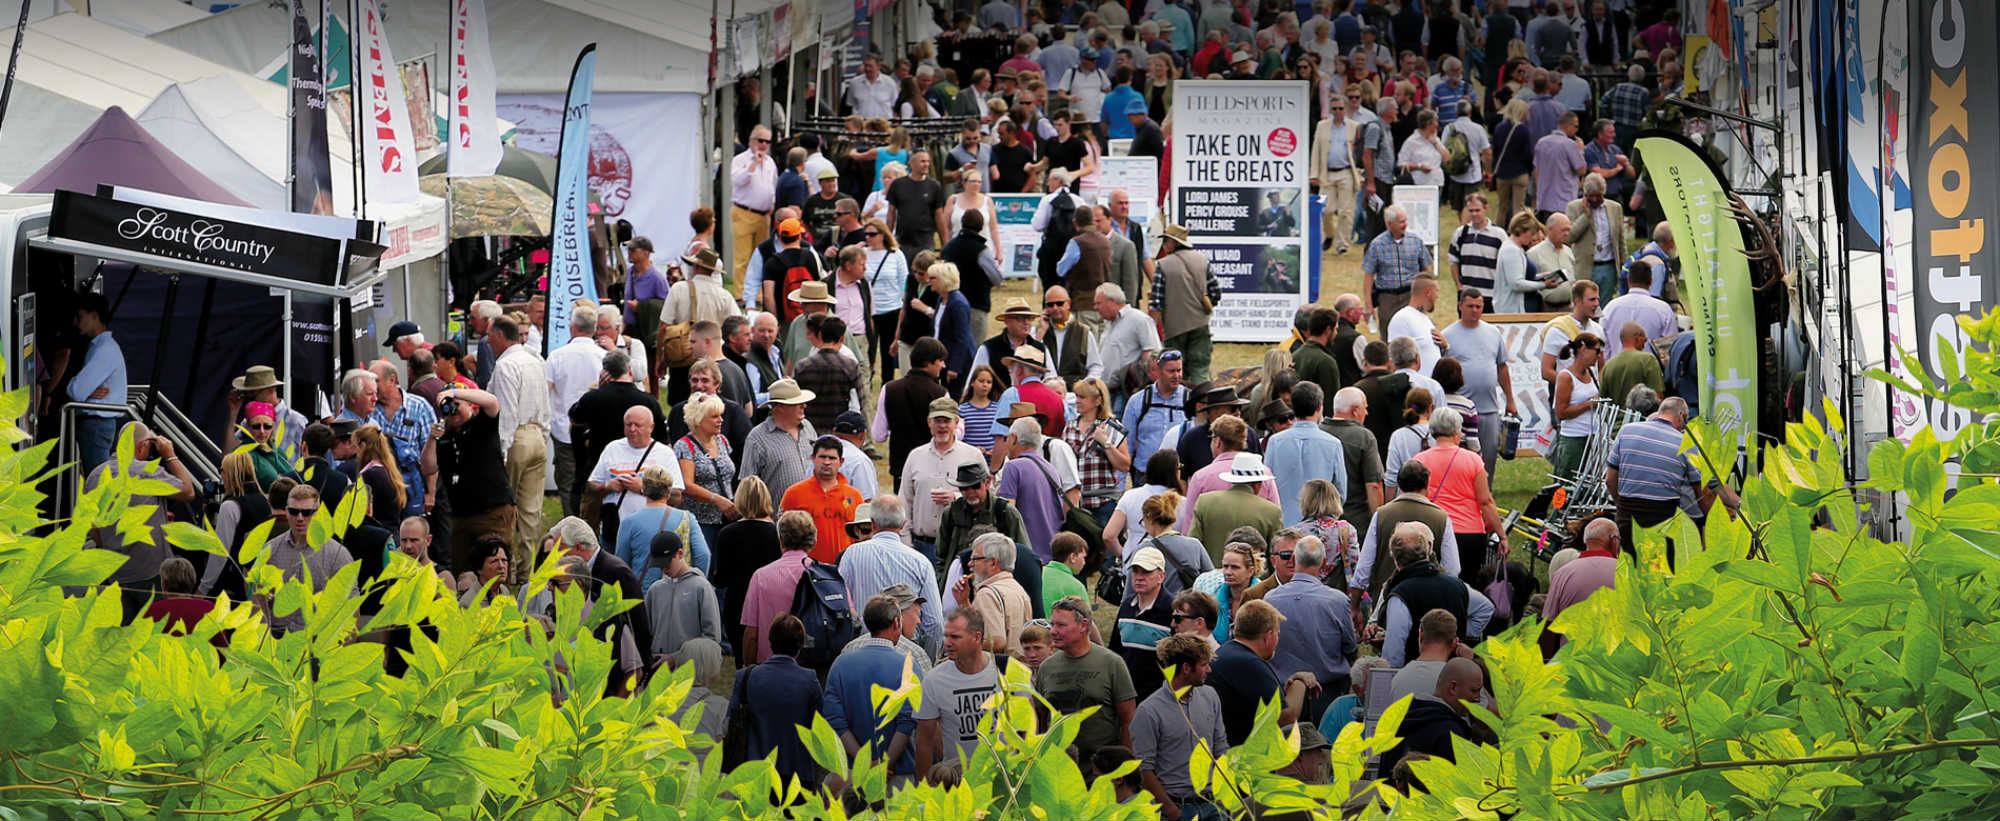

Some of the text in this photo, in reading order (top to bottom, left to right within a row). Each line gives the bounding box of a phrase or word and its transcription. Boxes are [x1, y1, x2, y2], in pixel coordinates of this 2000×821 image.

[1185, 95, 1296, 111] FIELDSPORTS
[1185, 134, 1232, 156] TAKE
[1237, 134, 1262, 156] ON
[1185, 160, 1295, 182] THE GREATS
[1185, 191, 1240, 203] LORD JAMES
[1185, 205, 1249, 217] PERCY GROUSE
[1185, 219, 1236, 231] CHALLENGE
[117, 207, 275, 264] Scott Country
[143, 246, 255, 271] INTERNATIONAL
[1215, 249, 1241, 260] WARD
